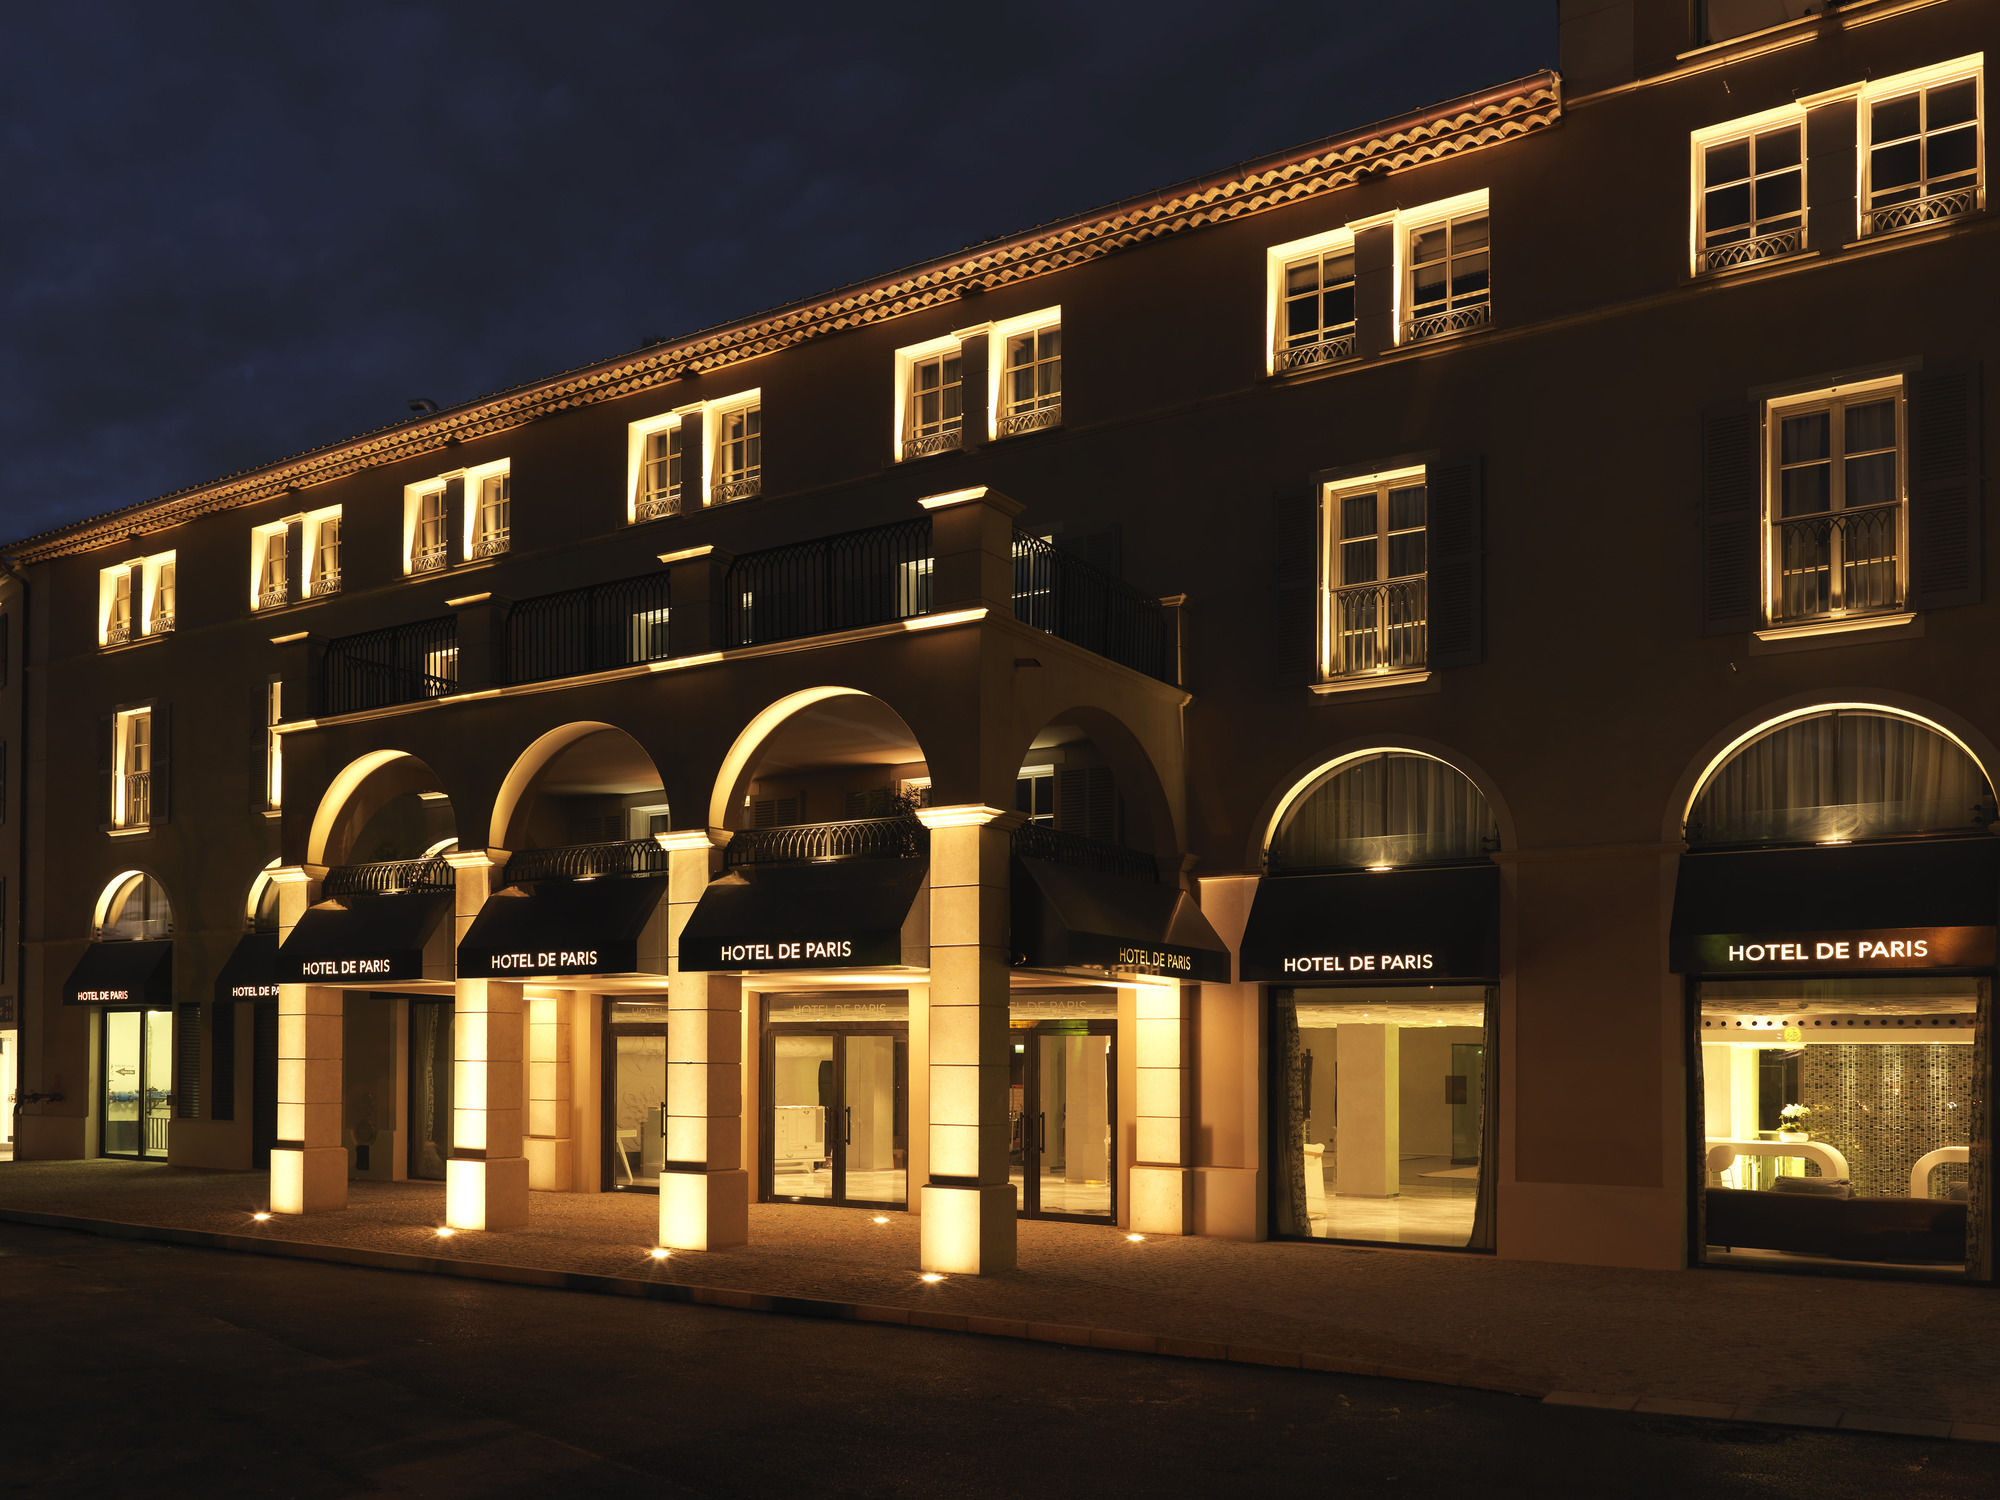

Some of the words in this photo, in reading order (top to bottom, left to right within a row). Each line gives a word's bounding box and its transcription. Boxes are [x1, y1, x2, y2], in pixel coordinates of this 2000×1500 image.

[491, 953, 535, 969] HOTEL
[537, 952, 557, 967] DE
[560, 950, 598, 967] PARIS
[721, 943, 774, 961] HOTEL
[778, 942, 801, 960] DE
[805, 940, 852, 958] PARIS
[1119, 947, 1151, 966] HOTEL
[1152, 951, 1166, 968] DE
[1167, 953, 1191, 971] PARIS
[1729, 943, 1809, 961] HOTEL
[1816, 942, 1850, 960] DE
[1858, 940, 1928, 959] PARIS
[302, 961, 339, 976] HOTEL
[341, 960, 357, 974] DE
[359, 959, 391, 974] PARIS
[1284, 956, 1345, 973] HOTEL
[1349, 955, 1376, 971] DE
[1381, 954, 1434, 970] PARIS
[77, 991, 99, 1001] HOTEL
[100, 991, 109, 1000] DE
[110, 990, 128, 1000] PARIS
[232, 986, 257, 997] HOTEL
[258, 986, 270, 996] DE
